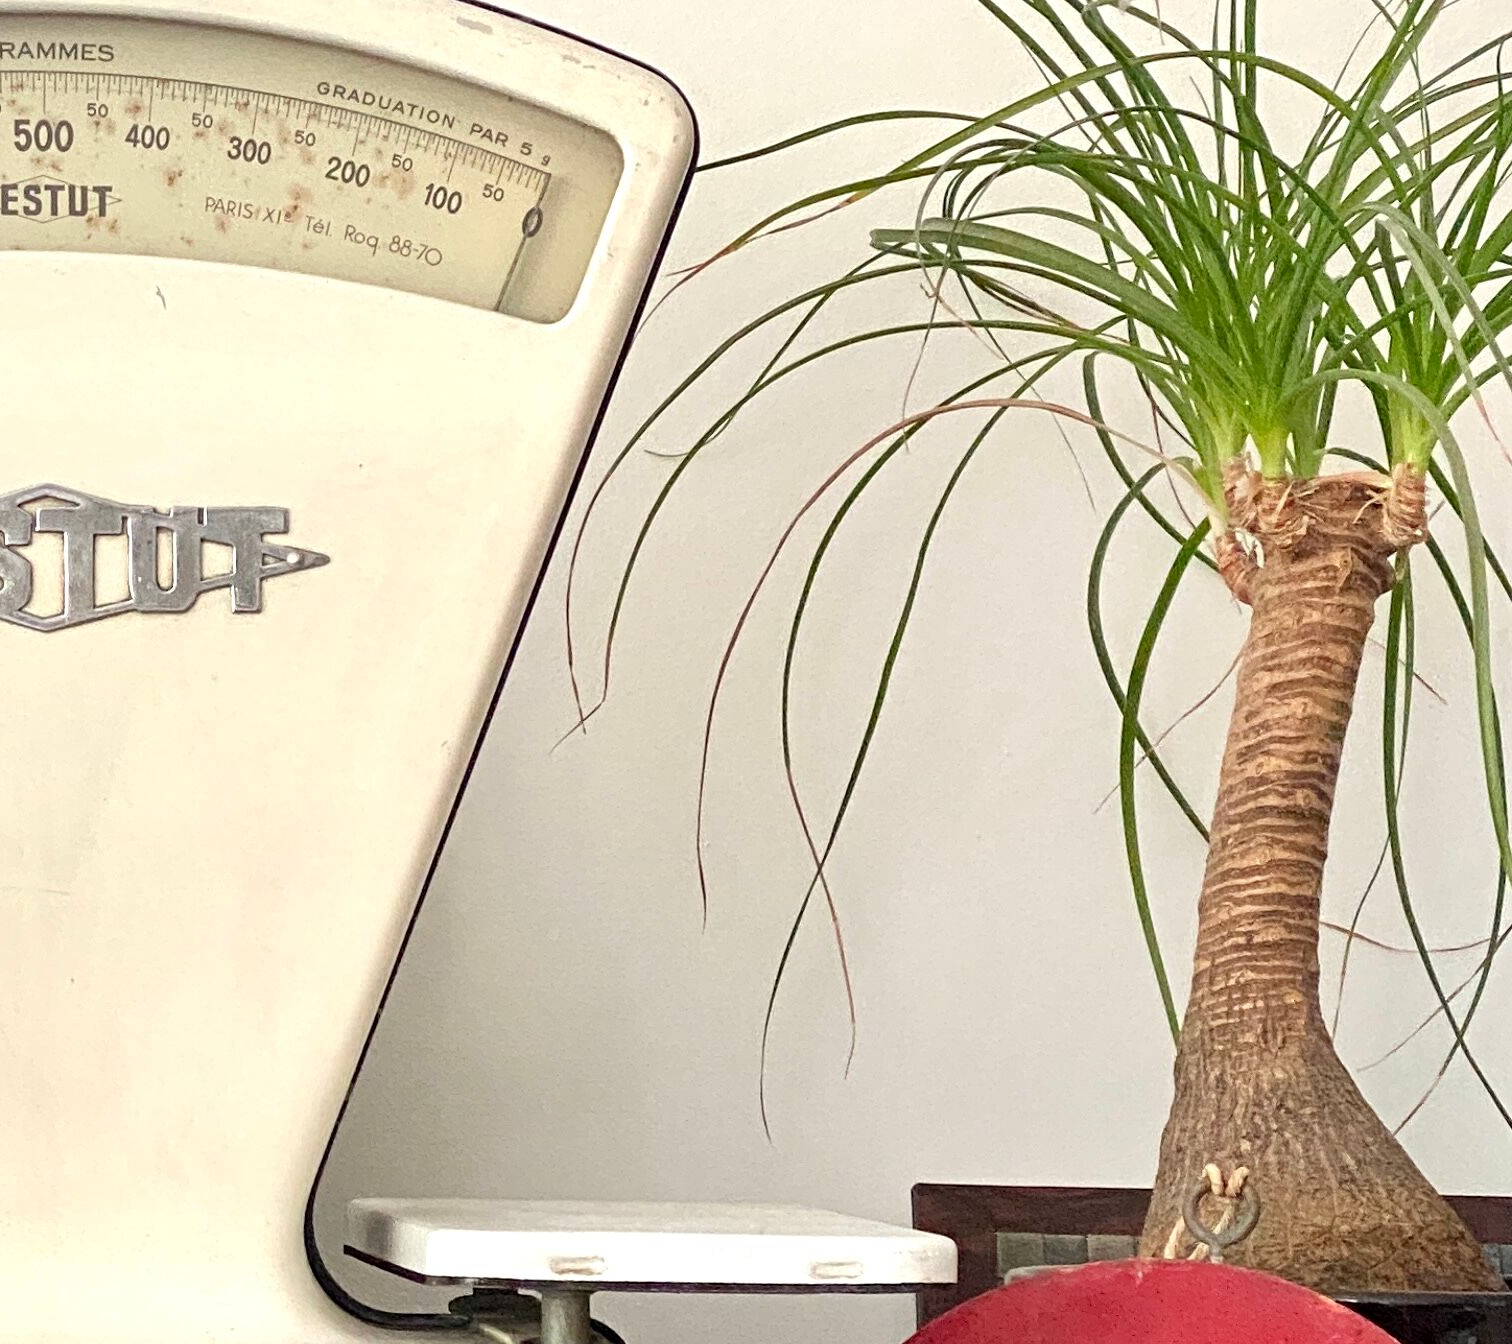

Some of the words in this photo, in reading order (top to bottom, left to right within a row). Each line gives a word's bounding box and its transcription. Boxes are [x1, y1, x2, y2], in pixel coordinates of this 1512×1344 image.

[13, 118, 74, 152] 500
[124, 124, 170, 150] 400
[227, 137, 272, 165] 300
[325, 156, 370, 187] 200
[425, 183, 462, 214] 100
[87, 102, 109, 118] 50
[191, 112, 213, 130] 50
[294, 129, 316, 147] 50
[391, 152, 413, 172] 50
[482, 183, 505, 202] 50
[317, 82, 455, 128] GRADUATION
[470, 123, 509, 147] PAR
[520, 143, 533, 156] 5
[541, 155, 552, 166] g
[204, 196, 253, 220] PARIS
[388, 234, 443, 266] 88-70
